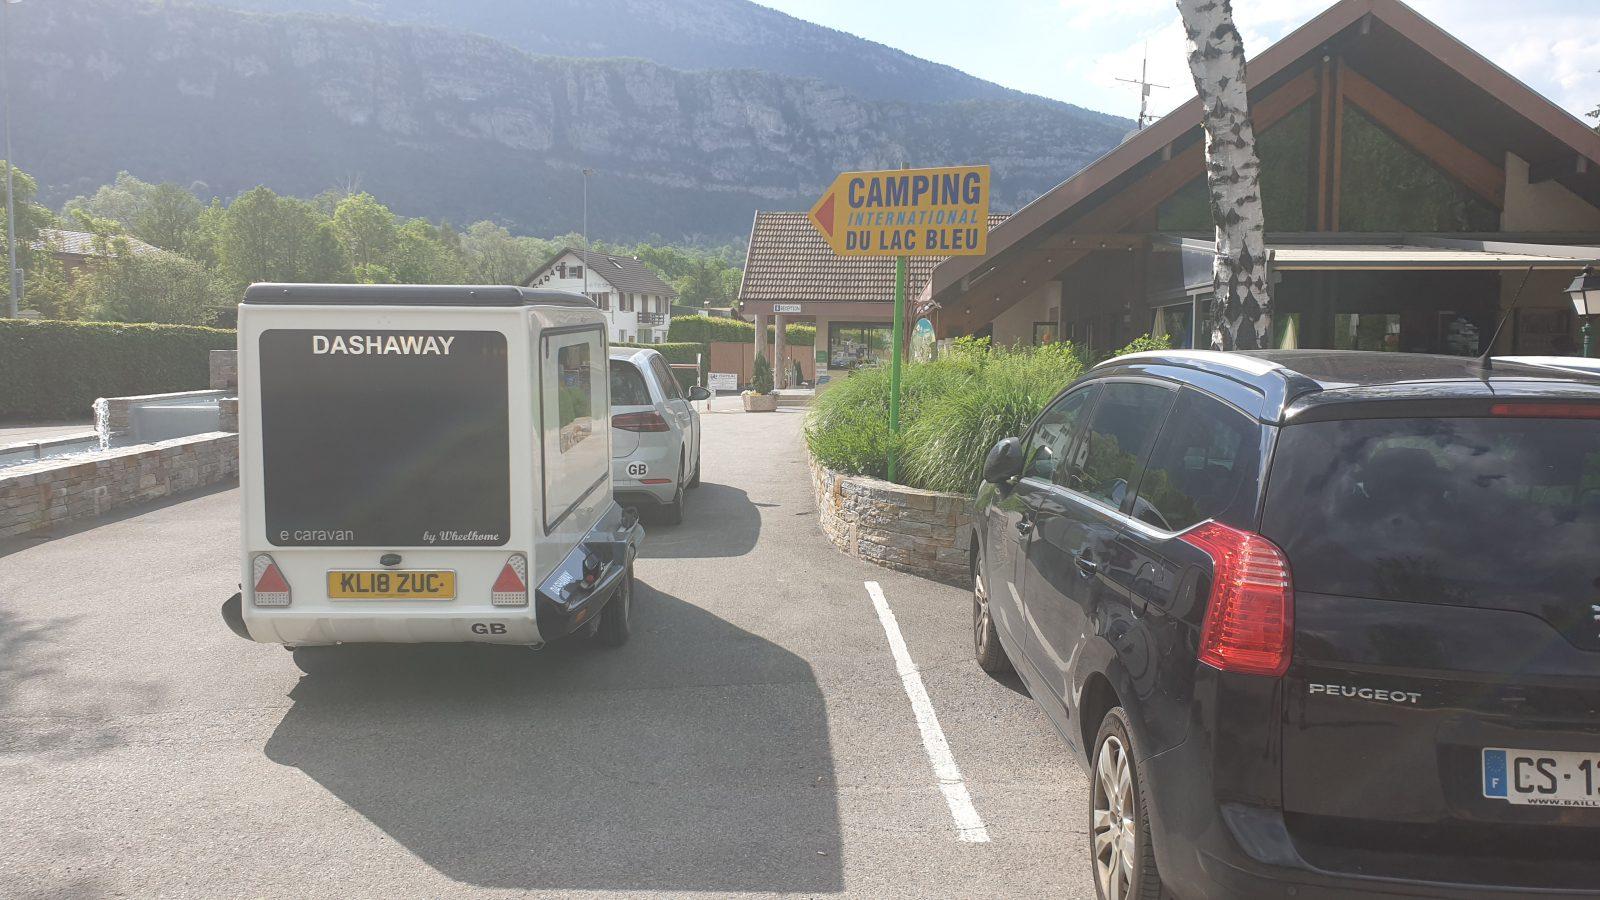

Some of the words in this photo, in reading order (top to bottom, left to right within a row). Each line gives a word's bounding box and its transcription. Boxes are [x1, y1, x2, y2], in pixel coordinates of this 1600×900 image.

[848, 172, 981, 208] CAMPING
[847, 209, 978, 227] INTERNATIONAL
[846, 230, 871, 250] DU
[879, 229, 916, 250] LAC
[925, 228, 979, 250] BLEU
[312, 335, 455, 355] DASHAWAY
[628, 464, 647, 476] GB
[280, 530, 289, 541] e
[294, 529, 354, 541] caravan
[423, 530, 436, 544] by
[439, 530, 500, 541] Wheelhome
[340, 573, 390, 593] KL18
[471, 622, 508, 635] GB
[1309, 683, 1422, 704] PEUGEOT
[1492, 778, 1500, 789] F
